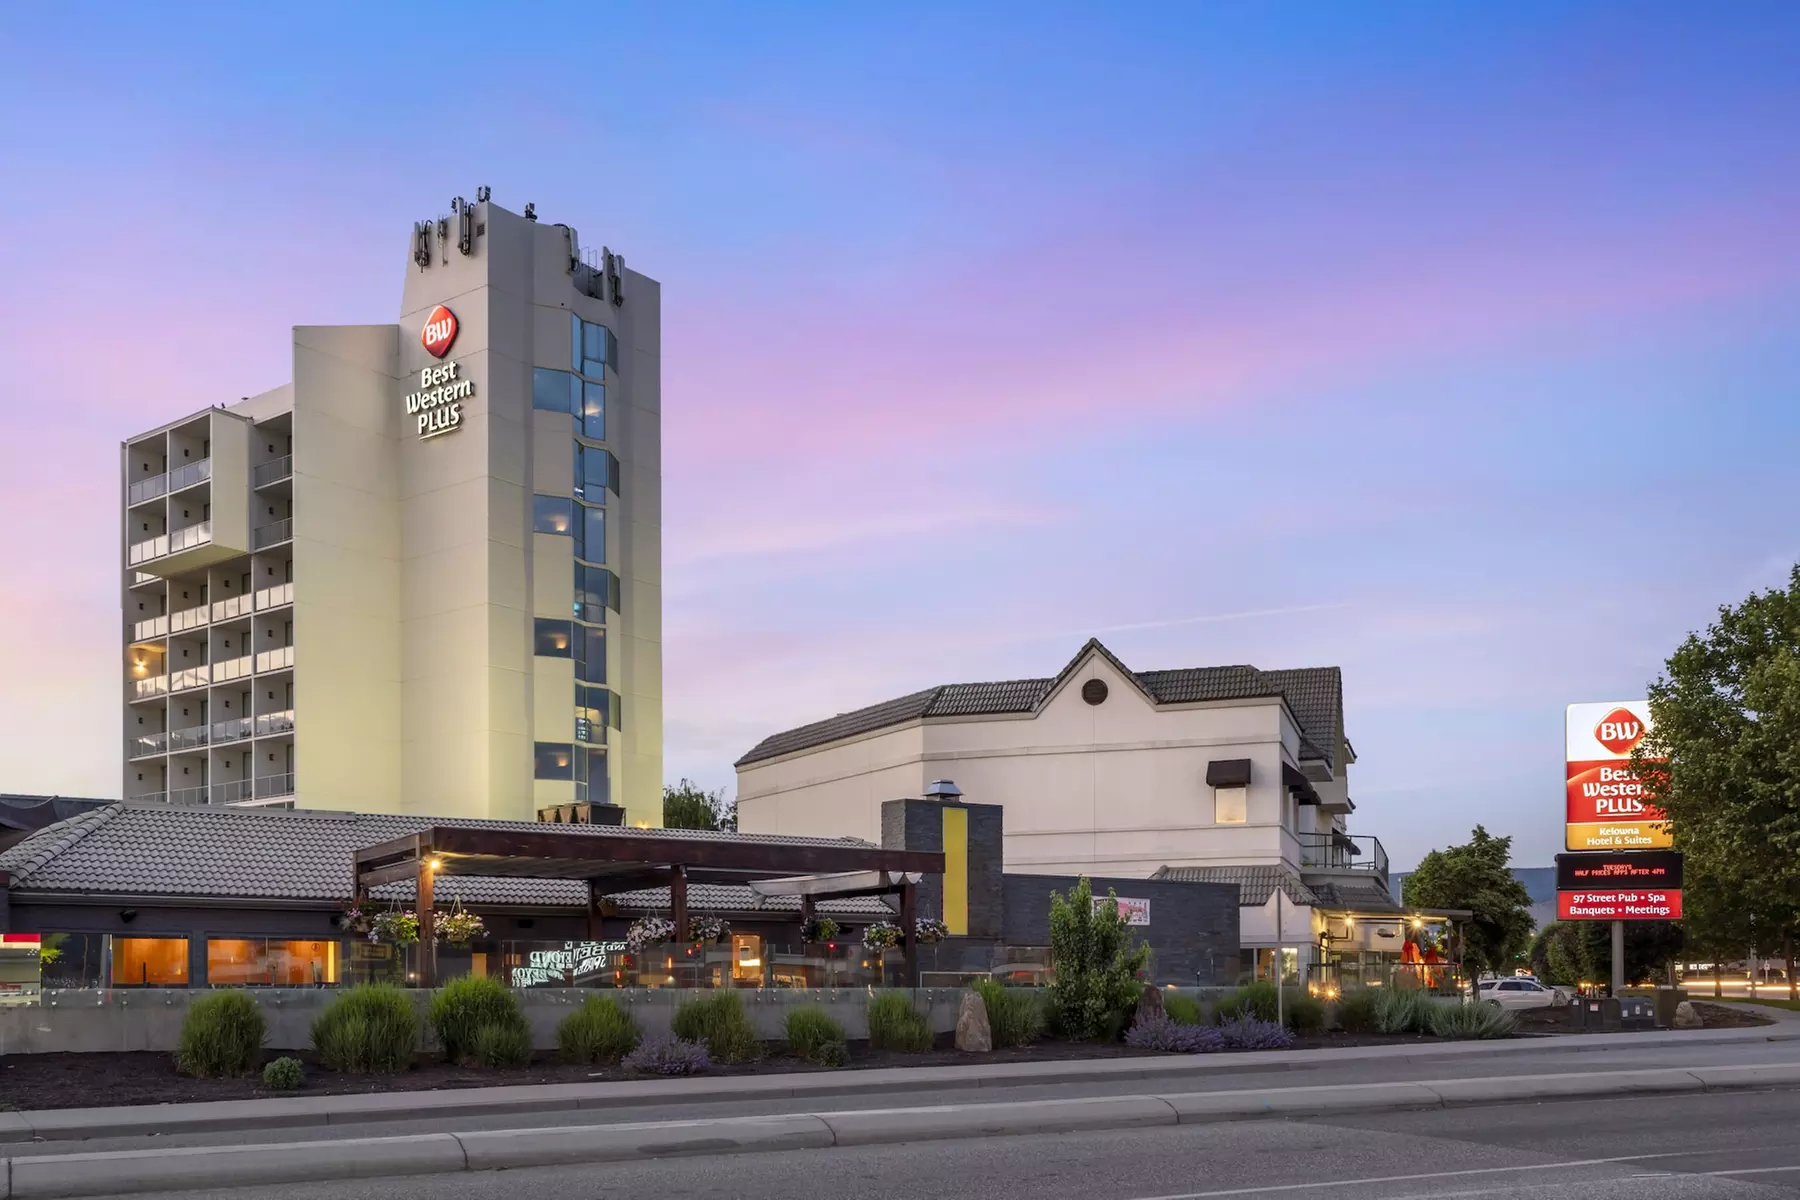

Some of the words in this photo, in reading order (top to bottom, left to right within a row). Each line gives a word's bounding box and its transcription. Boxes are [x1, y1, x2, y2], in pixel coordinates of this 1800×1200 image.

[425, 317, 452, 345] BW
[421, 361, 456, 388] Best
[406, 380, 471, 414] Western
[417, 403, 460, 434] PLUS
[1601, 721, 1639, 740] BW
[1582, 782, 1656, 797] Wester
[1599, 827, 1640, 836] Kelowna
[1586, 837, 1613, 846] Hotel
[1614, 836, 1622, 845] &
[1624, 835, 1653, 845] Suites
[1573, 895, 1584, 903] 97
[1587, 894, 1616, 902] Street
[1618, 893, 1638, 902] Pub
[1647, 893, 1666, 903] Spa
[1569, 906, 1615, 916] Banquets
[1625, 905, 1670, 916] Meetings
